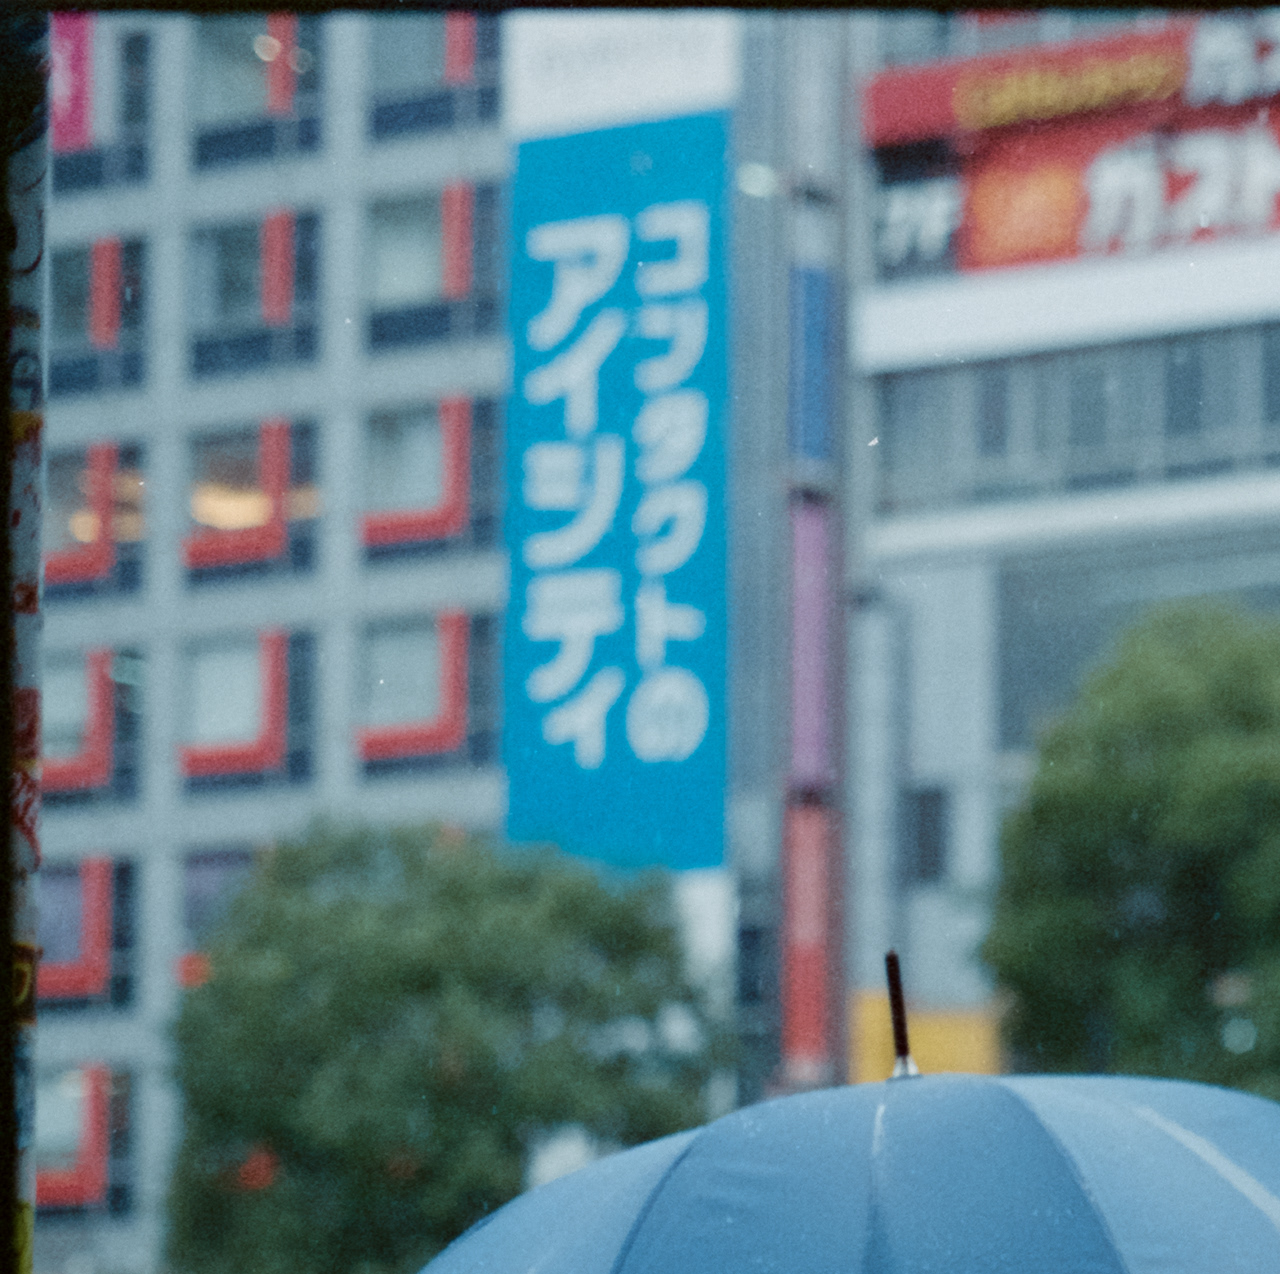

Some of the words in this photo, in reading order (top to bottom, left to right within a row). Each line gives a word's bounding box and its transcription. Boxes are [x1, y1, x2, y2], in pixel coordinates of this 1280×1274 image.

[523, 212, 630, 770] アイシティ
[626, 200, 711, 763] コンタクトの
